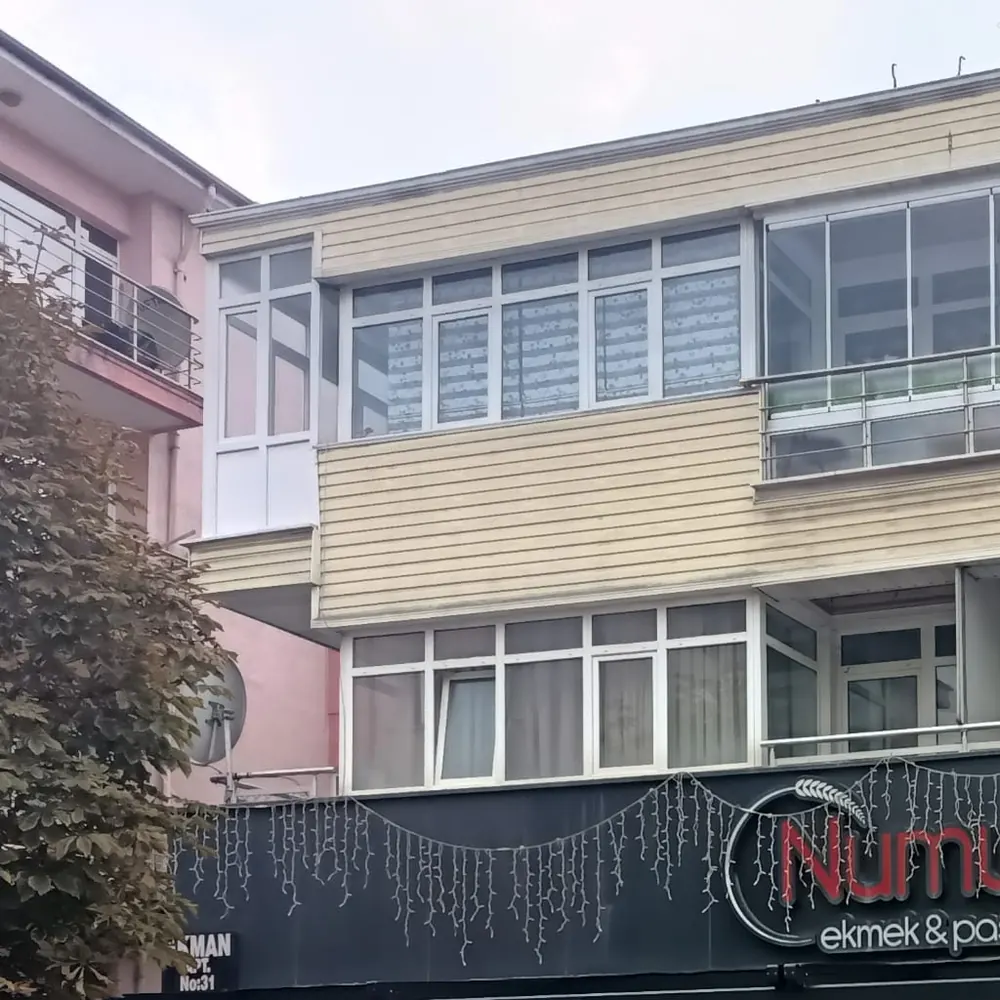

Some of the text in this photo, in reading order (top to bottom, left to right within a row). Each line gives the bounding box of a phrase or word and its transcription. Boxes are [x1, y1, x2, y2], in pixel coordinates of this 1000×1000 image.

[820, 919, 919, 950] ekmek
[925, 913, 949, 943] &
[166, 932, 232, 958] KMAN
[179, 974, 215, 992] No:31
